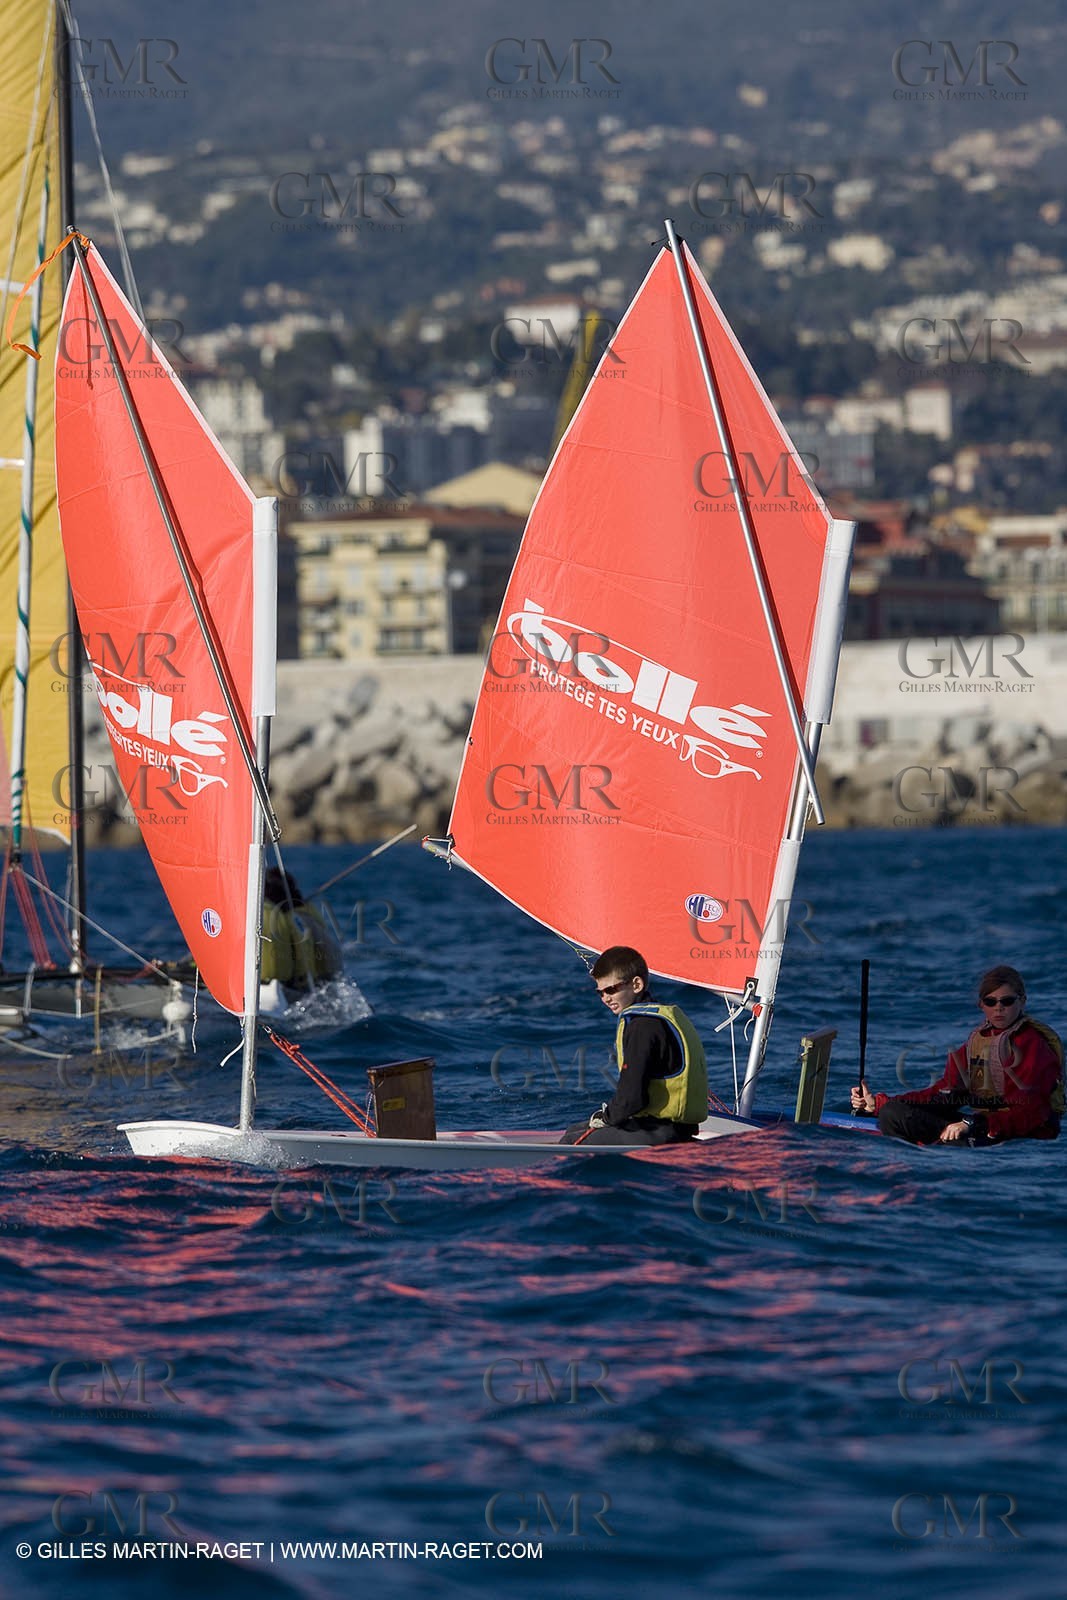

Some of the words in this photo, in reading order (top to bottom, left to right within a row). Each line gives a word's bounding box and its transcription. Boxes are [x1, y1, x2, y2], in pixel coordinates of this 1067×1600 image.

[93, 670, 229, 756] ollé
[521, 598, 773, 749] bollé
[530, 658, 596, 709] PROTEGE
[598, 696, 628, 725] TES
[631, 713, 680, 750] YEUX
[121, 736, 142, 758] TES
[142, 744, 170, 773] YEUX
